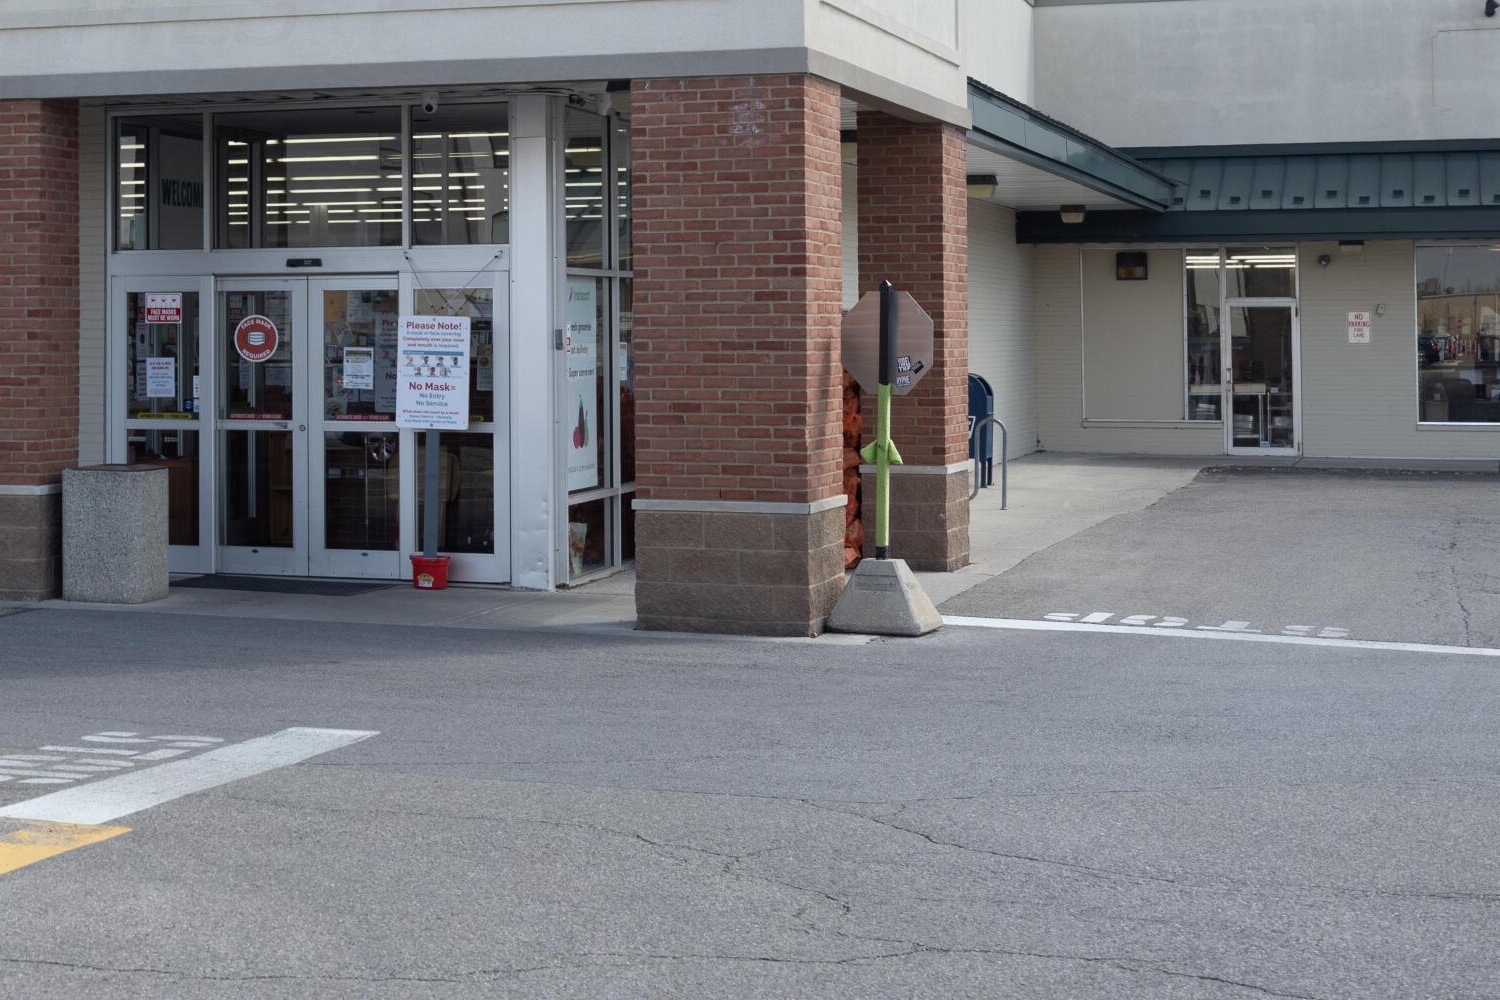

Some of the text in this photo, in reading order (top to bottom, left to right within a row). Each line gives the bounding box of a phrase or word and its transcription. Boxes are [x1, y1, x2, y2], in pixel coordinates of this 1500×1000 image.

[240, 318, 272, 330] FACE MASK
[406, 321, 436, 330] Please
[437, 322, 462, 330] Note!
[241, 348, 271, 360] REQUIRED
[409, 382, 423, 390] No
